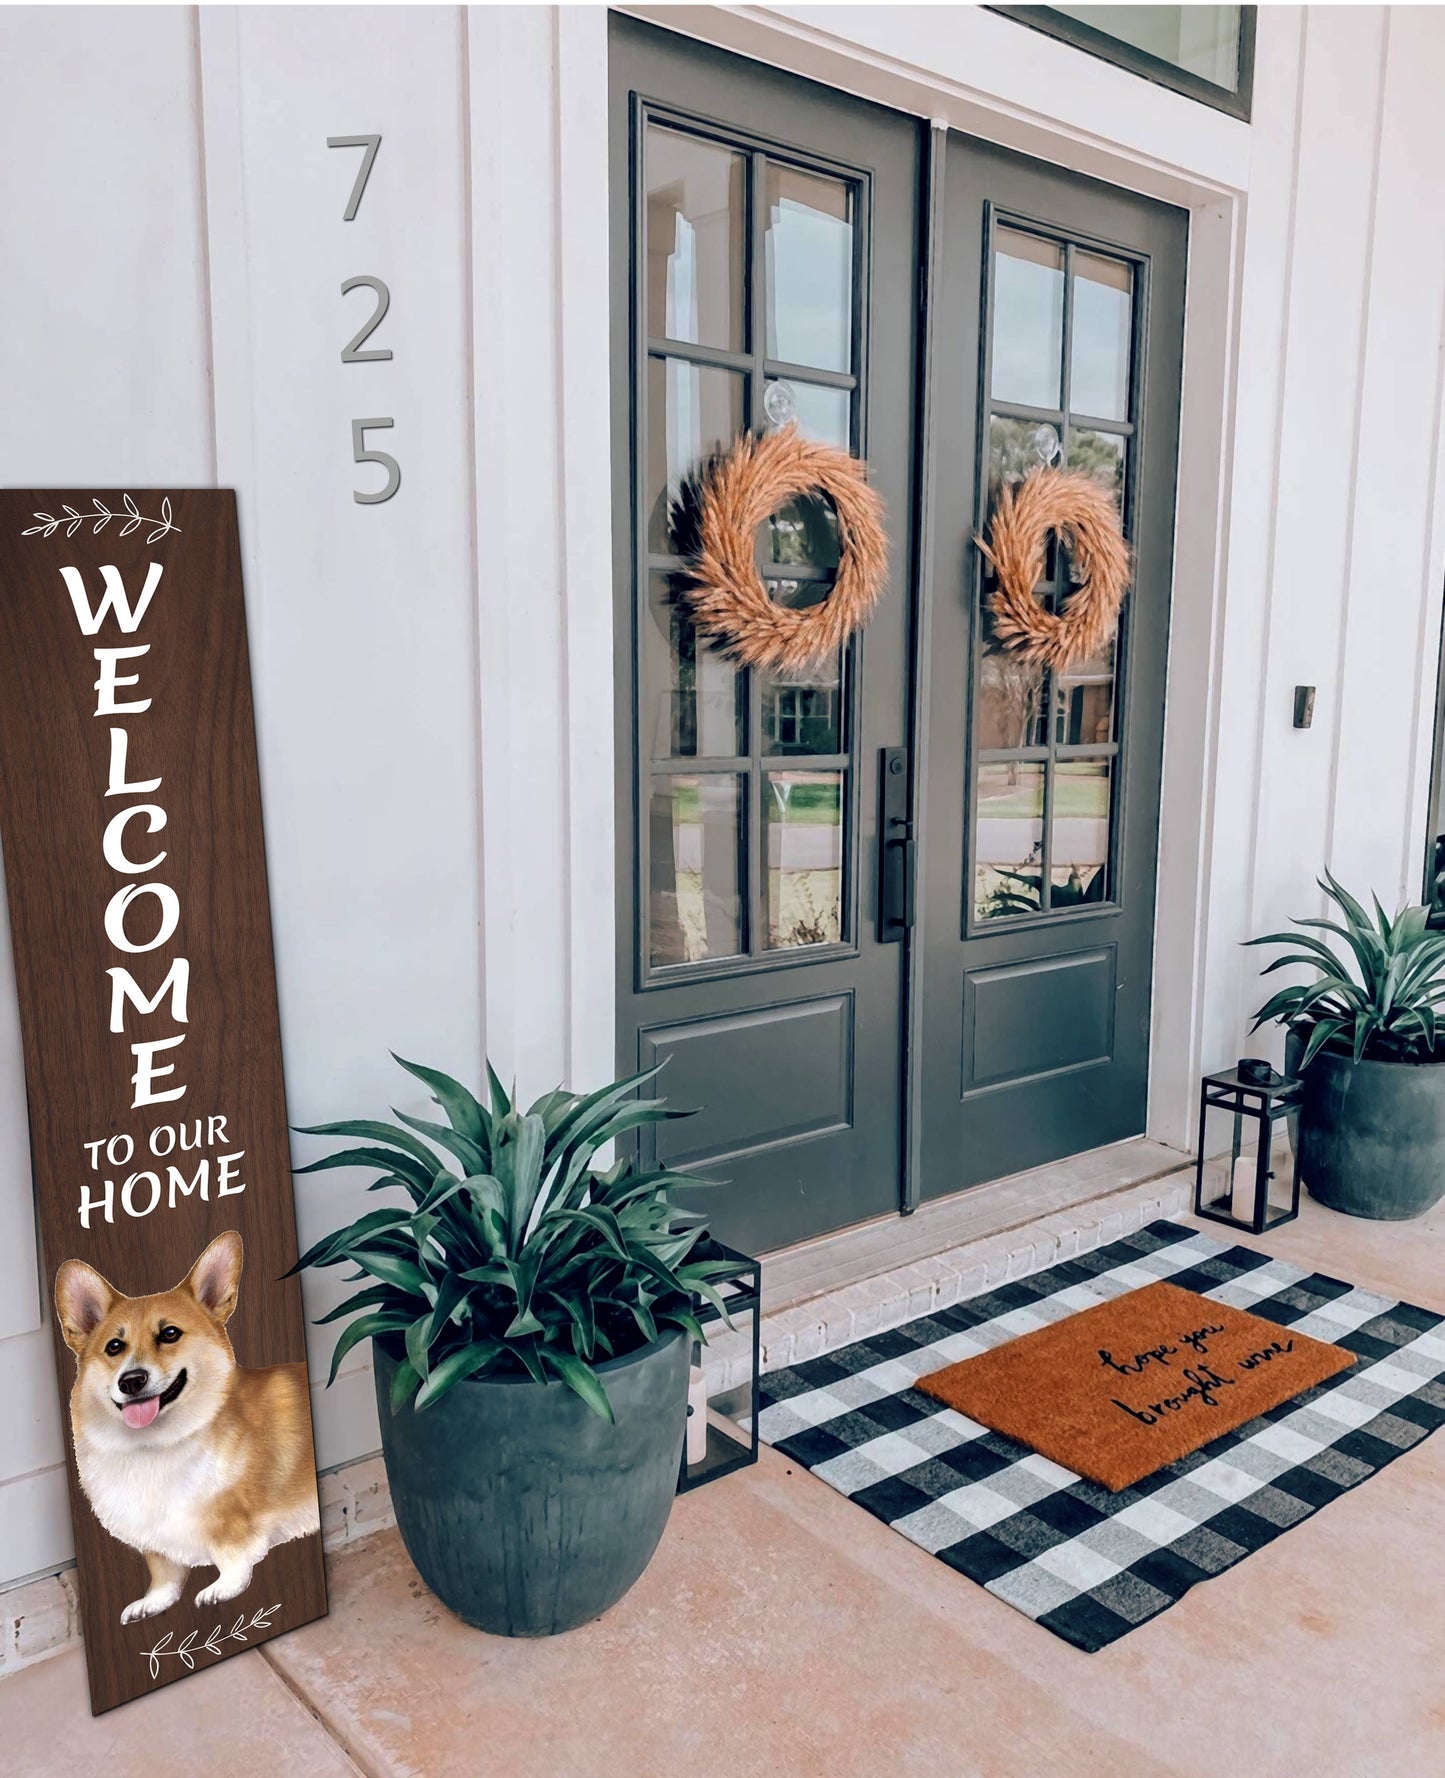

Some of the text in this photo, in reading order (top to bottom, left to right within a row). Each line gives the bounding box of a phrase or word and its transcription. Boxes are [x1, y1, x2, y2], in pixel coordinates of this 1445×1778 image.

[326, 134, 401, 505] 725
[59, 562, 190, 1109] WELCOME
[83, 1115, 230, 1170] TO OUR
[77, 1150, 246, 1229] HOME
[1098, 1324, 1225, 1375] hope you
[1110, 1364, 1235, 1425] brought
